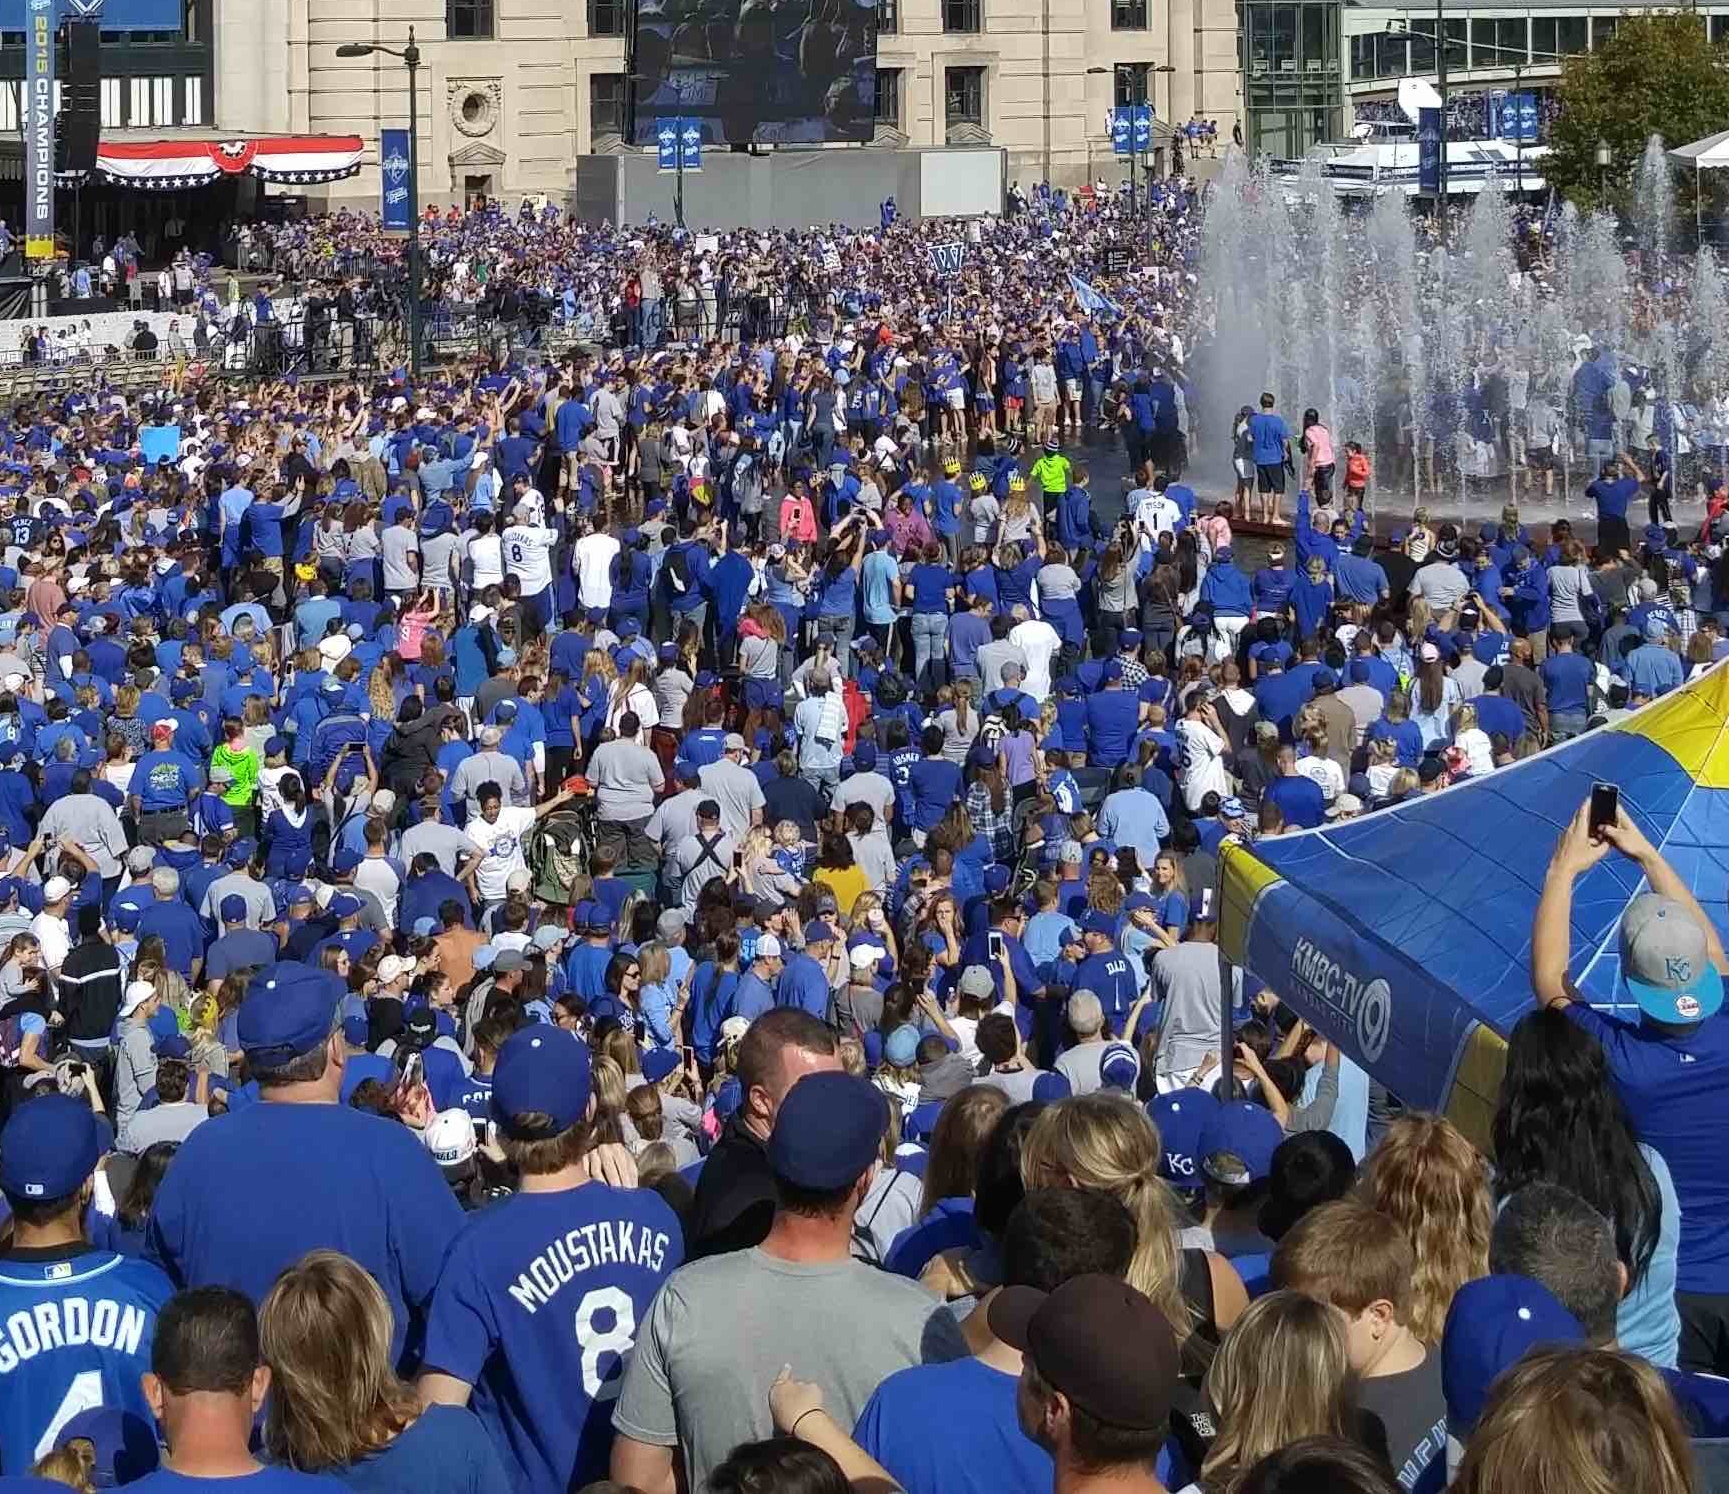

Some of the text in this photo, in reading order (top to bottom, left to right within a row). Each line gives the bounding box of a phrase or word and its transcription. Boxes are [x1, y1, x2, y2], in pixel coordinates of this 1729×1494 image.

[35, 16, 50, 220] 2015 CHAMPIONS
[928, 244, 963, 275] W
[12, 519, 32, 527] PEREZ
[1153, 513, 1157, 530] 1
[15, 527, 31, 544] 13
[511, 544, 523, 562] 8
[7, 726, 16, 741] 8
[1104, 961, 1126, 974] DAD
[1292, 937, 1364, 1016] KMBC-TV
[1665, 954, 1690, 981] KC
[1166, 1153, 1194, 1175] KC
[508, 1221, 669, 1314] MOUSTAKAS
[575, 1286, 635, 1399] 8
[34, 1369, 104, 1465] 4
